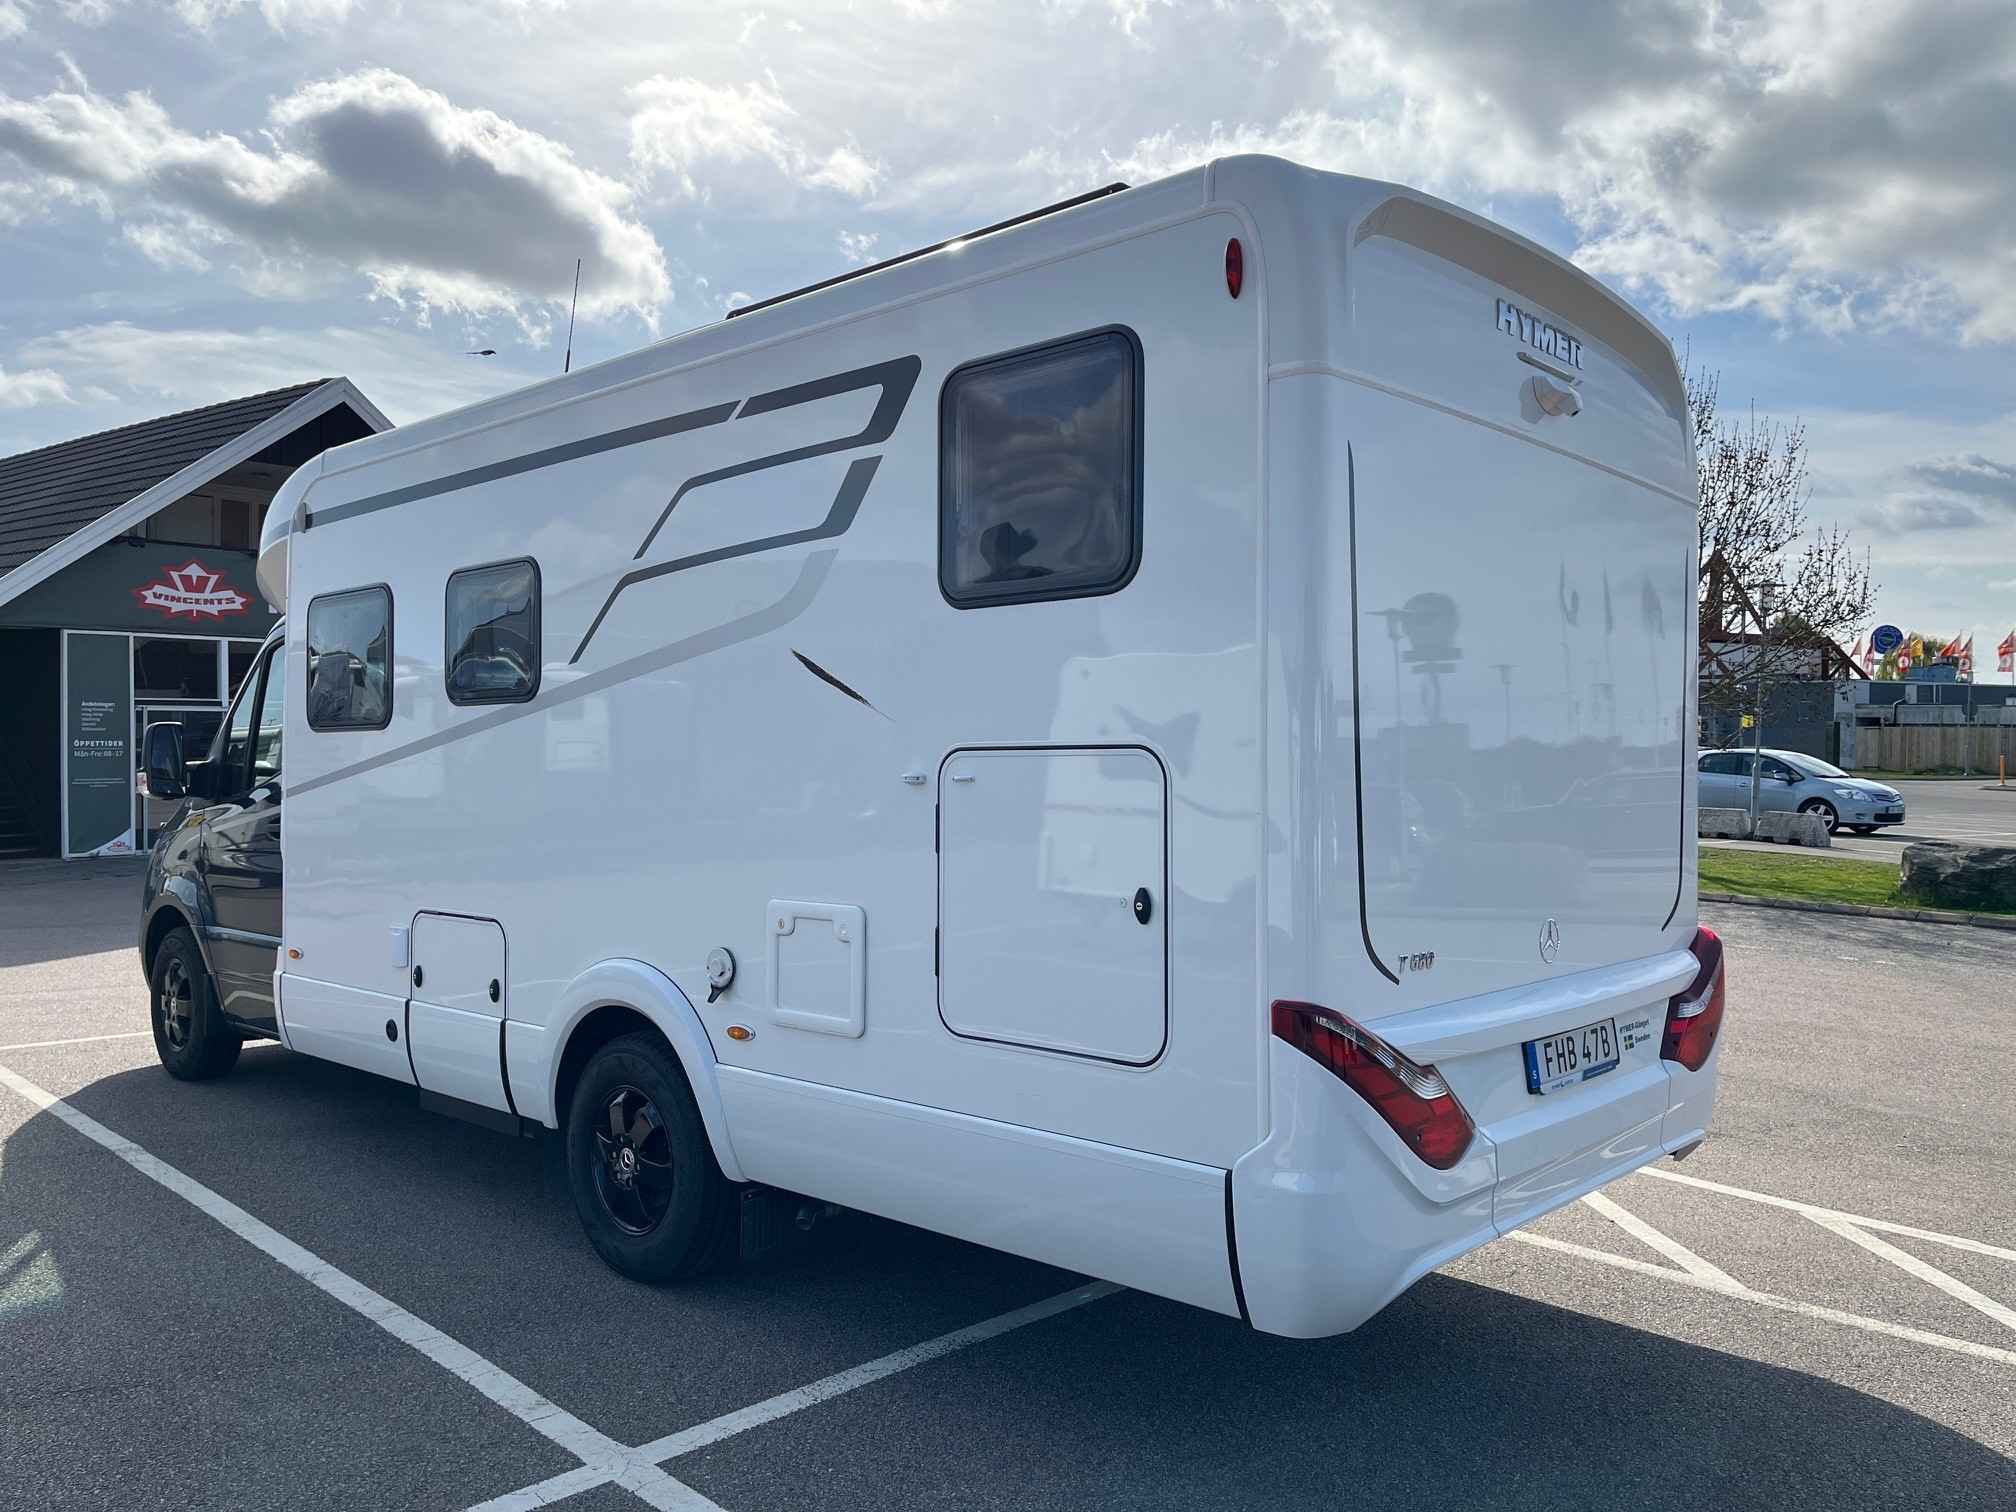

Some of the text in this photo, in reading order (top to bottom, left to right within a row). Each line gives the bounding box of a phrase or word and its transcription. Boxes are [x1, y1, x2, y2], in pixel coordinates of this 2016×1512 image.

[1496, 297, 1584, 370] HYMER
[152, 591, 236, 606] VINCENTS
[73, 739, 124, 747] ÖPPETTIDER
[1398, 954, 1409, 974] T
[1634, 1033, 1651, 1044] Sweden
[1543, 1025, 1611, 1078] FHB 47B
[1532, 1069, 1538, 1080] S
